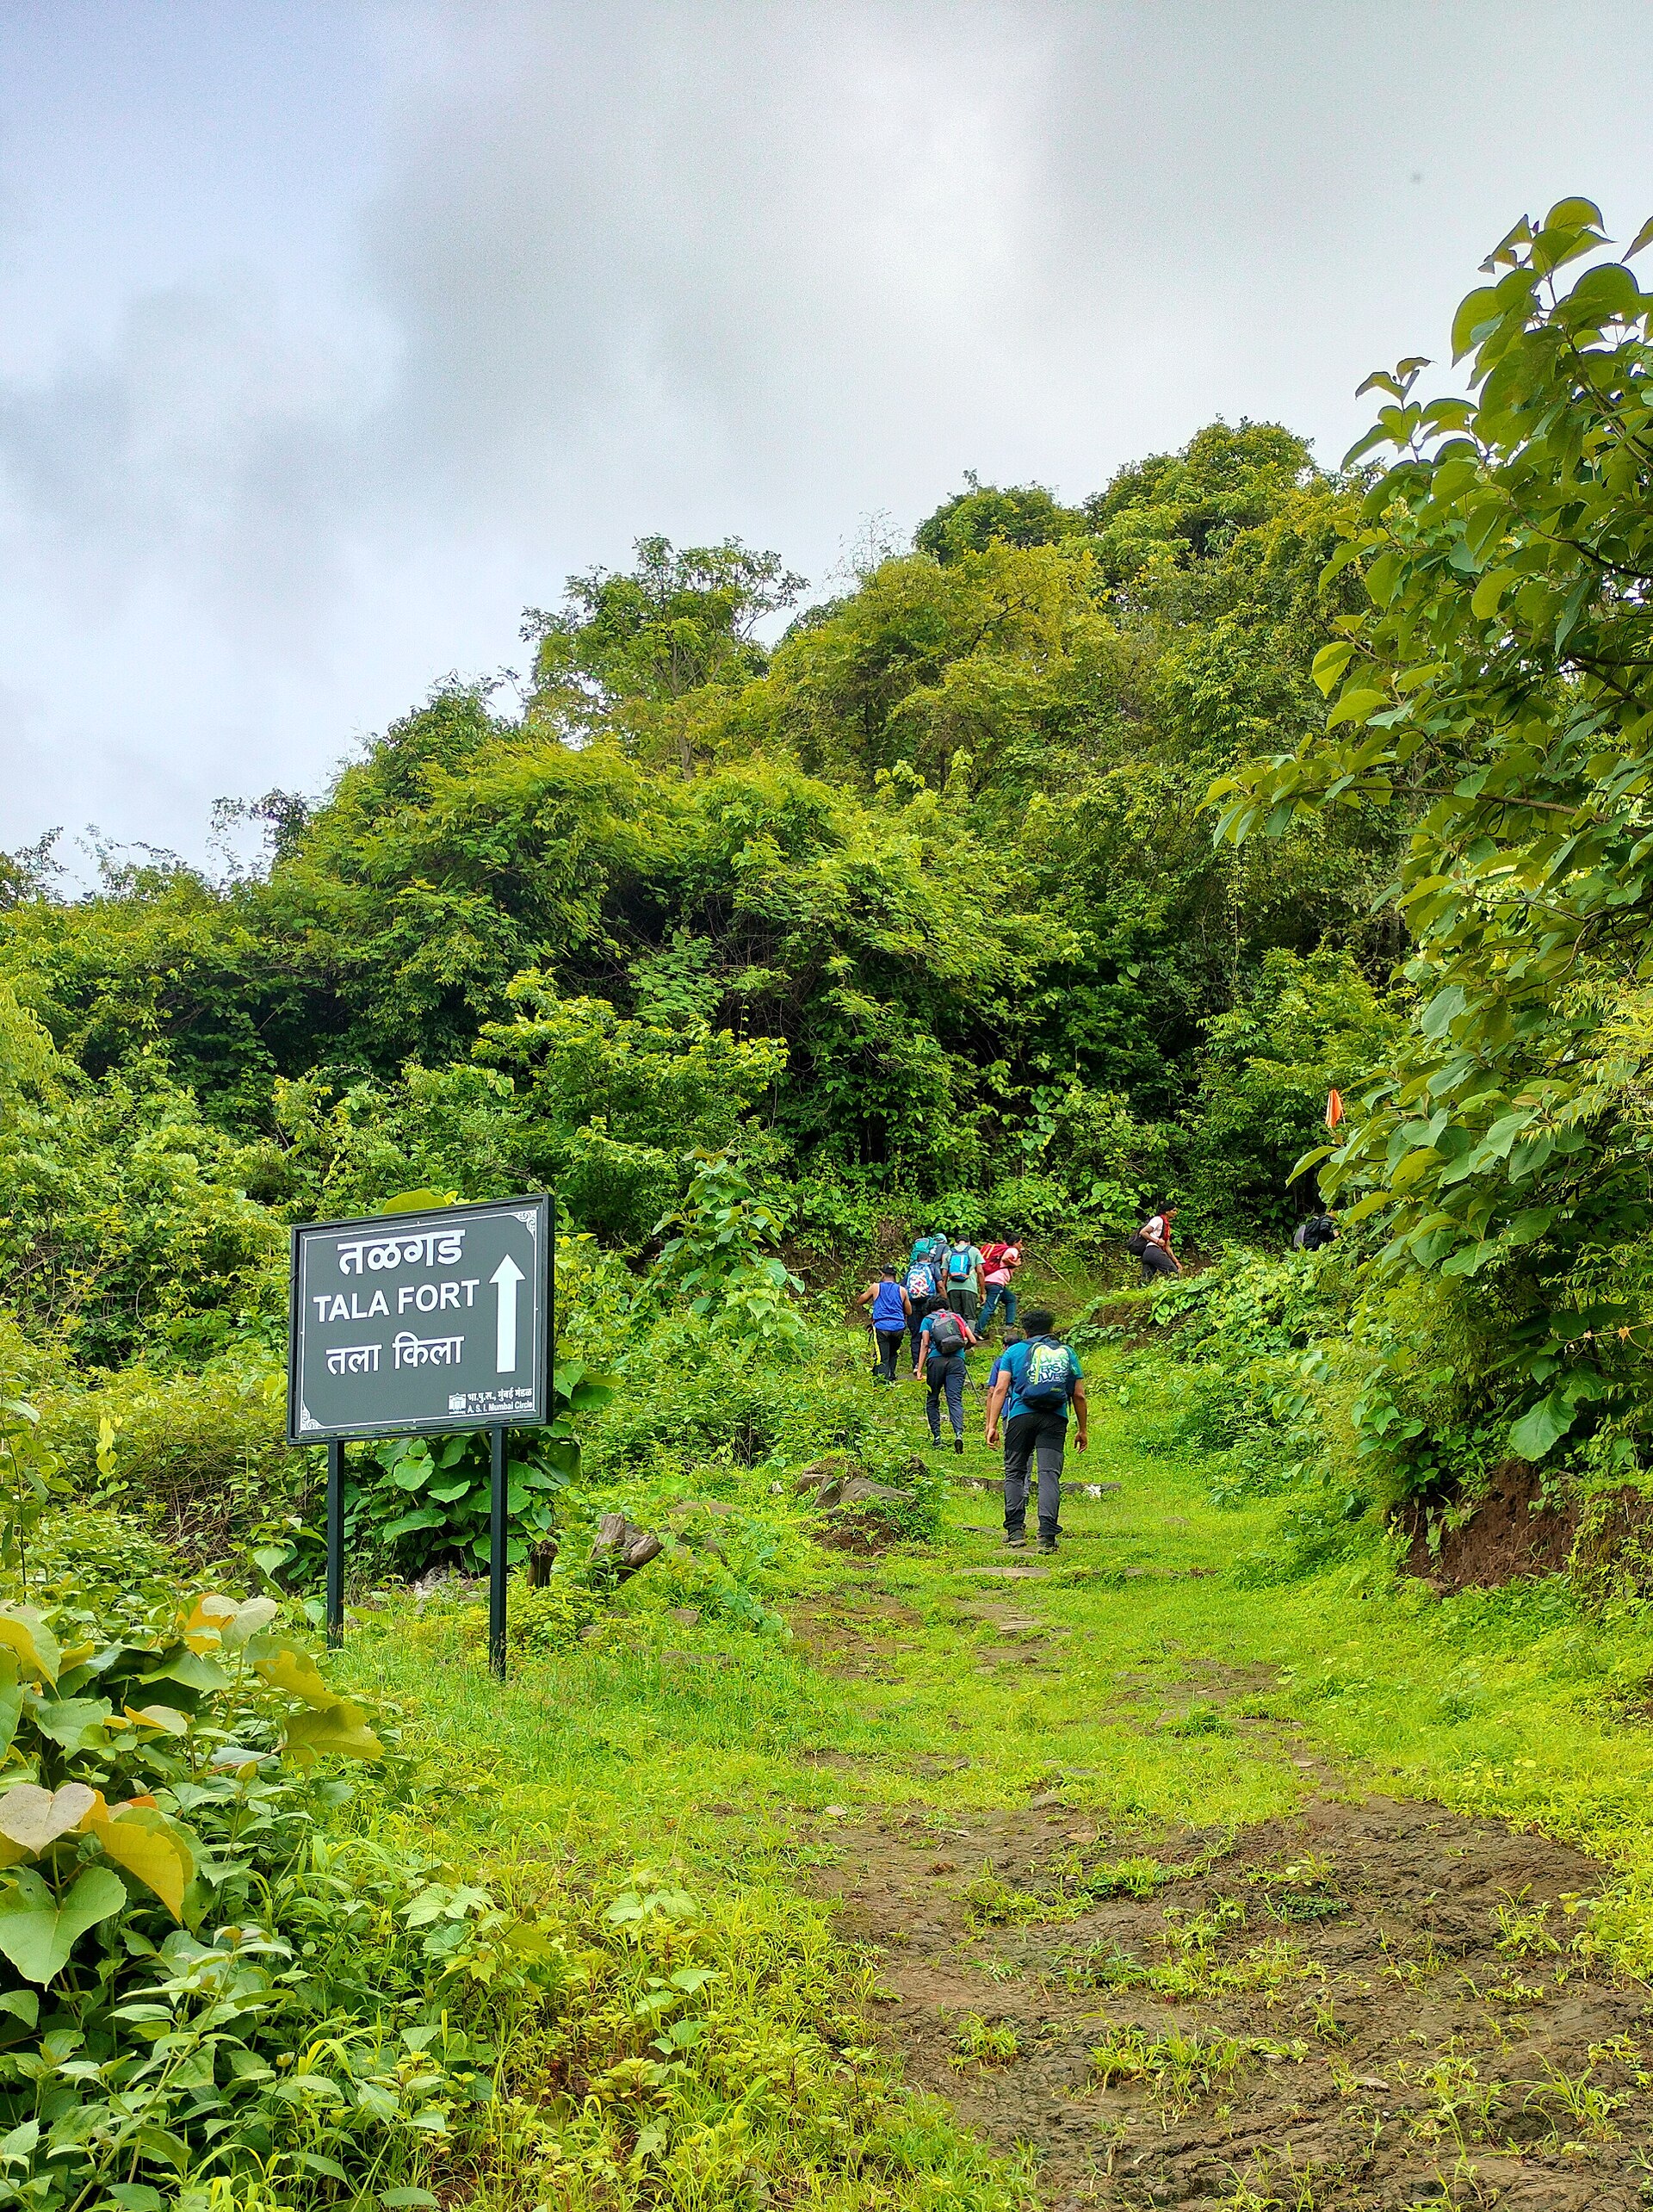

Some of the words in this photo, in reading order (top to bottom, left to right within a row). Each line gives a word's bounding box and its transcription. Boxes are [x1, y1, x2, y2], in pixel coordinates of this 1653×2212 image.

[337, 1229, 466, 1275] तळगड
[313, 1290, 390, 1323] TALA
[397, 1279, 480, 1315] FORT
[325, 1344, 382, 1376] तला
[392, 1331, 465, 1370] किला
[488, 1401, 513, 1411] Mumbai
[515, 1400, 533, 1410] Circle
